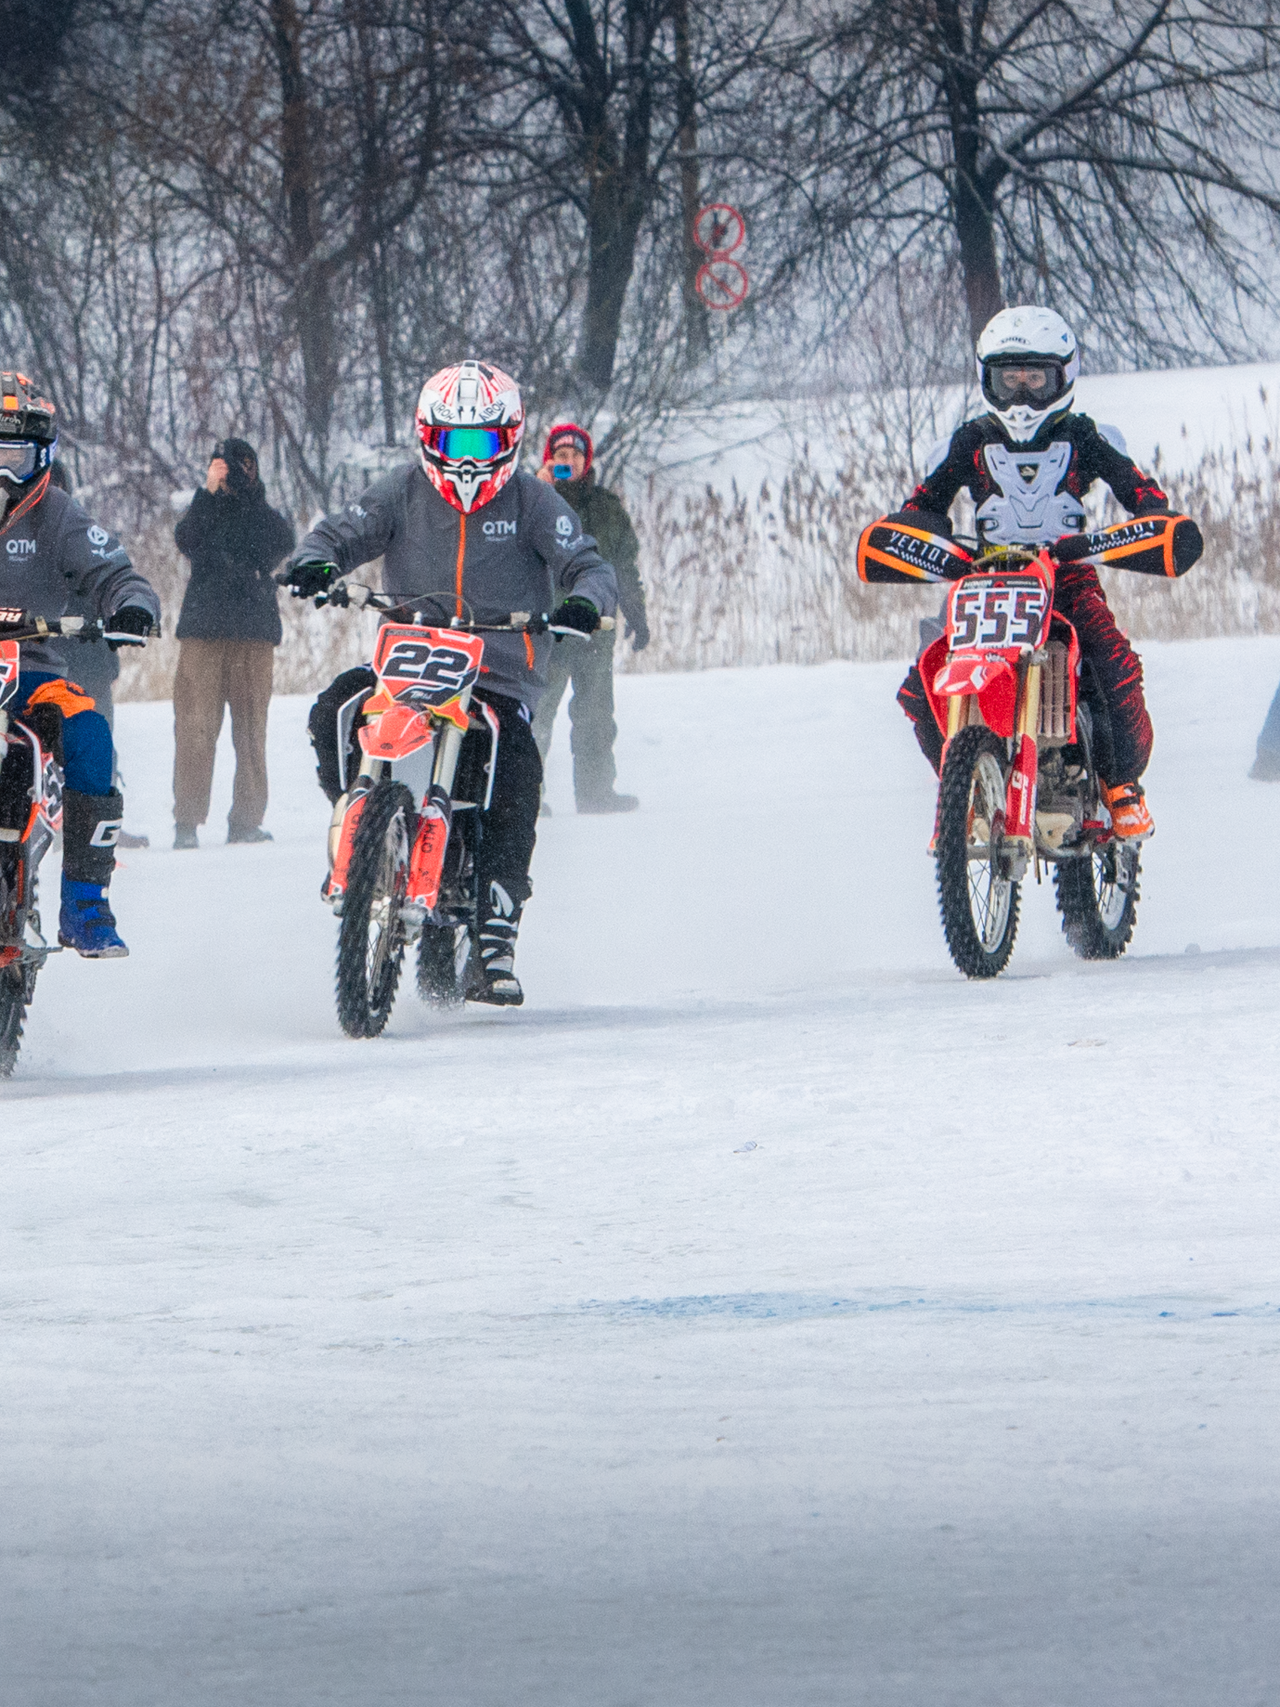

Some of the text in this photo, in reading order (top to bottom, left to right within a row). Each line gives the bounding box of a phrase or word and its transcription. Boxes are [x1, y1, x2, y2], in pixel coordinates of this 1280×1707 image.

[429, 399, 456, 421] AIROH
[479, 398, 505, 421] AIROH
[482, 520, 517, 535] QTM
[6, 539, 36, 554] QTM
[950, 588, 1046, 651] 555
[380, 641, 473, 690] 22
